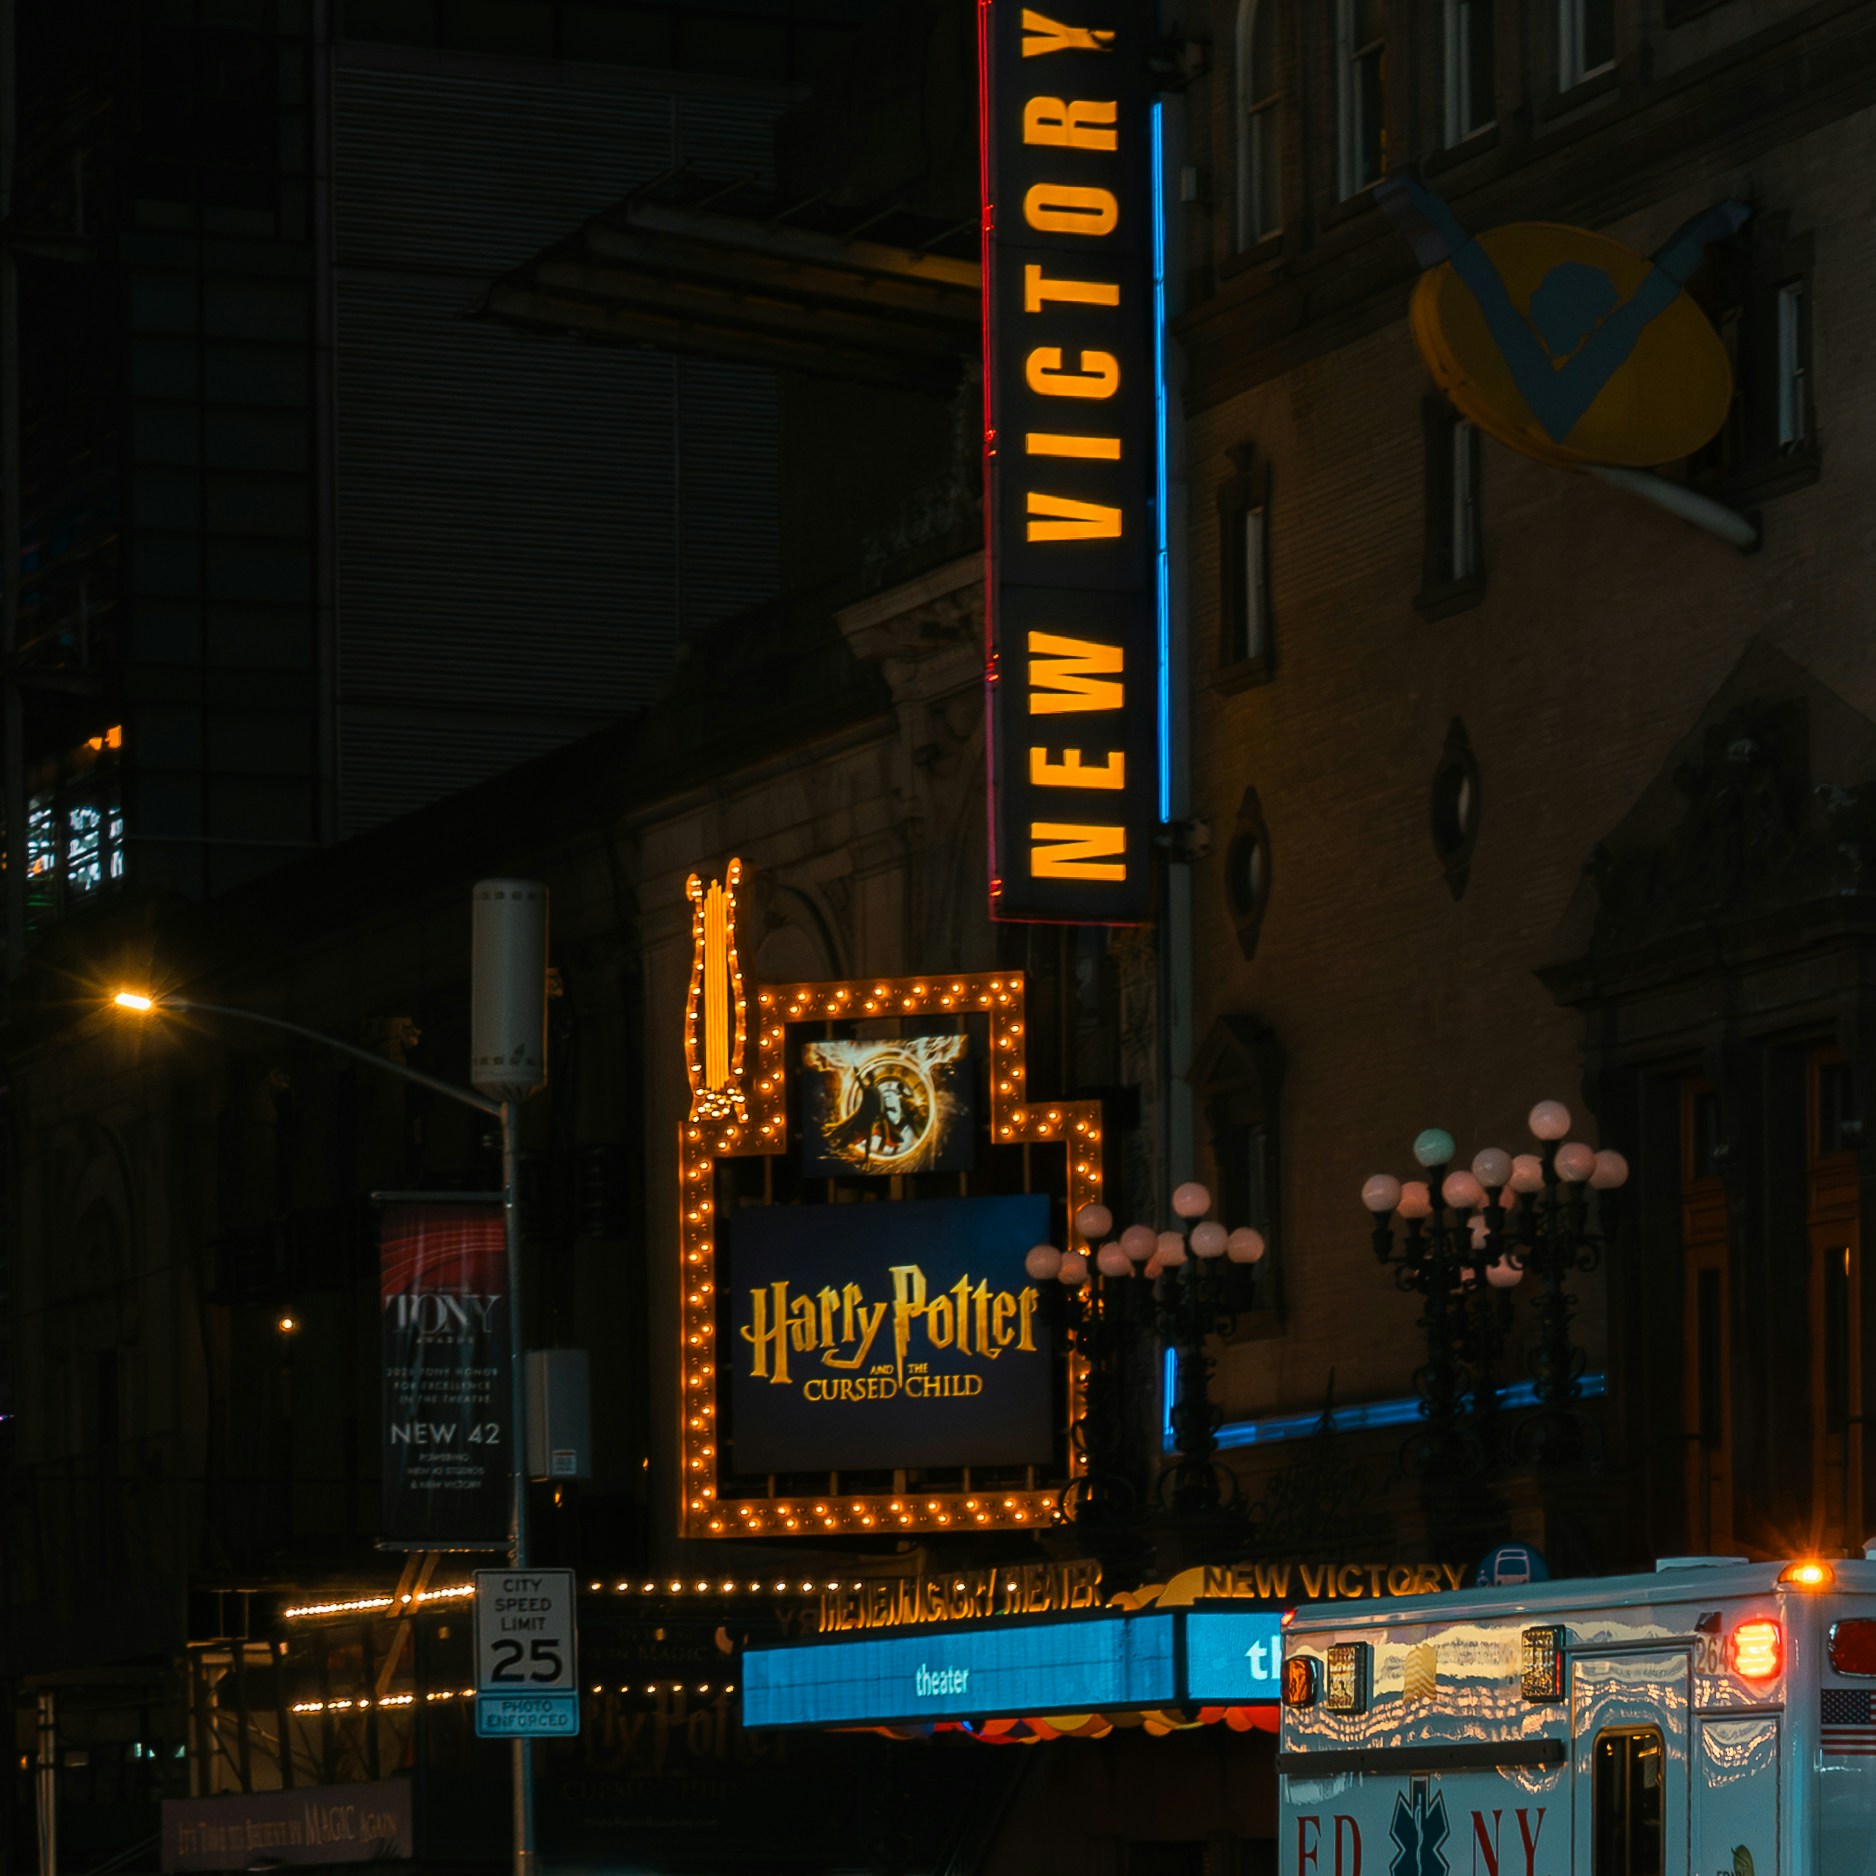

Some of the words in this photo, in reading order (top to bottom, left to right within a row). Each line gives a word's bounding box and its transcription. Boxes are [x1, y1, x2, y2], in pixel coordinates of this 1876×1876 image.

[1021, 8, 1122, 544] VICTORY
[1027, 629, 1127, 882] NEW
[384, 1293, 502, 1334] TONY
[740, 1280, 888, 1385] Harry
[889, 1264, 1041, 1389] Potter
[870, 1365, 894, 1375] AND
[907, 1363, 928, 1373] THE
[803, 1378, 897, 1402] CURSED
[905, 1374, 983, 1398] CHILD
[390, 1421, 457, 1445] NEW
[467, 1421, 500, 1444] 42
[503, 1579, 543, 1592] CITY
[1203, 1563, 1292, 1599] NEW
[1300, 1562, 1468, 1599] VICTORY
[495, 1598, 552, 1612] SPEED
[502, 1617, 546, 1631] LIMIT
[491, 1639, 563, 1682] 25
[916, 1663, 969, 1696] theater
[487, 1714, 567, 1727] ENFORCED
[502, 1701, 552, 1712] PHOTO
